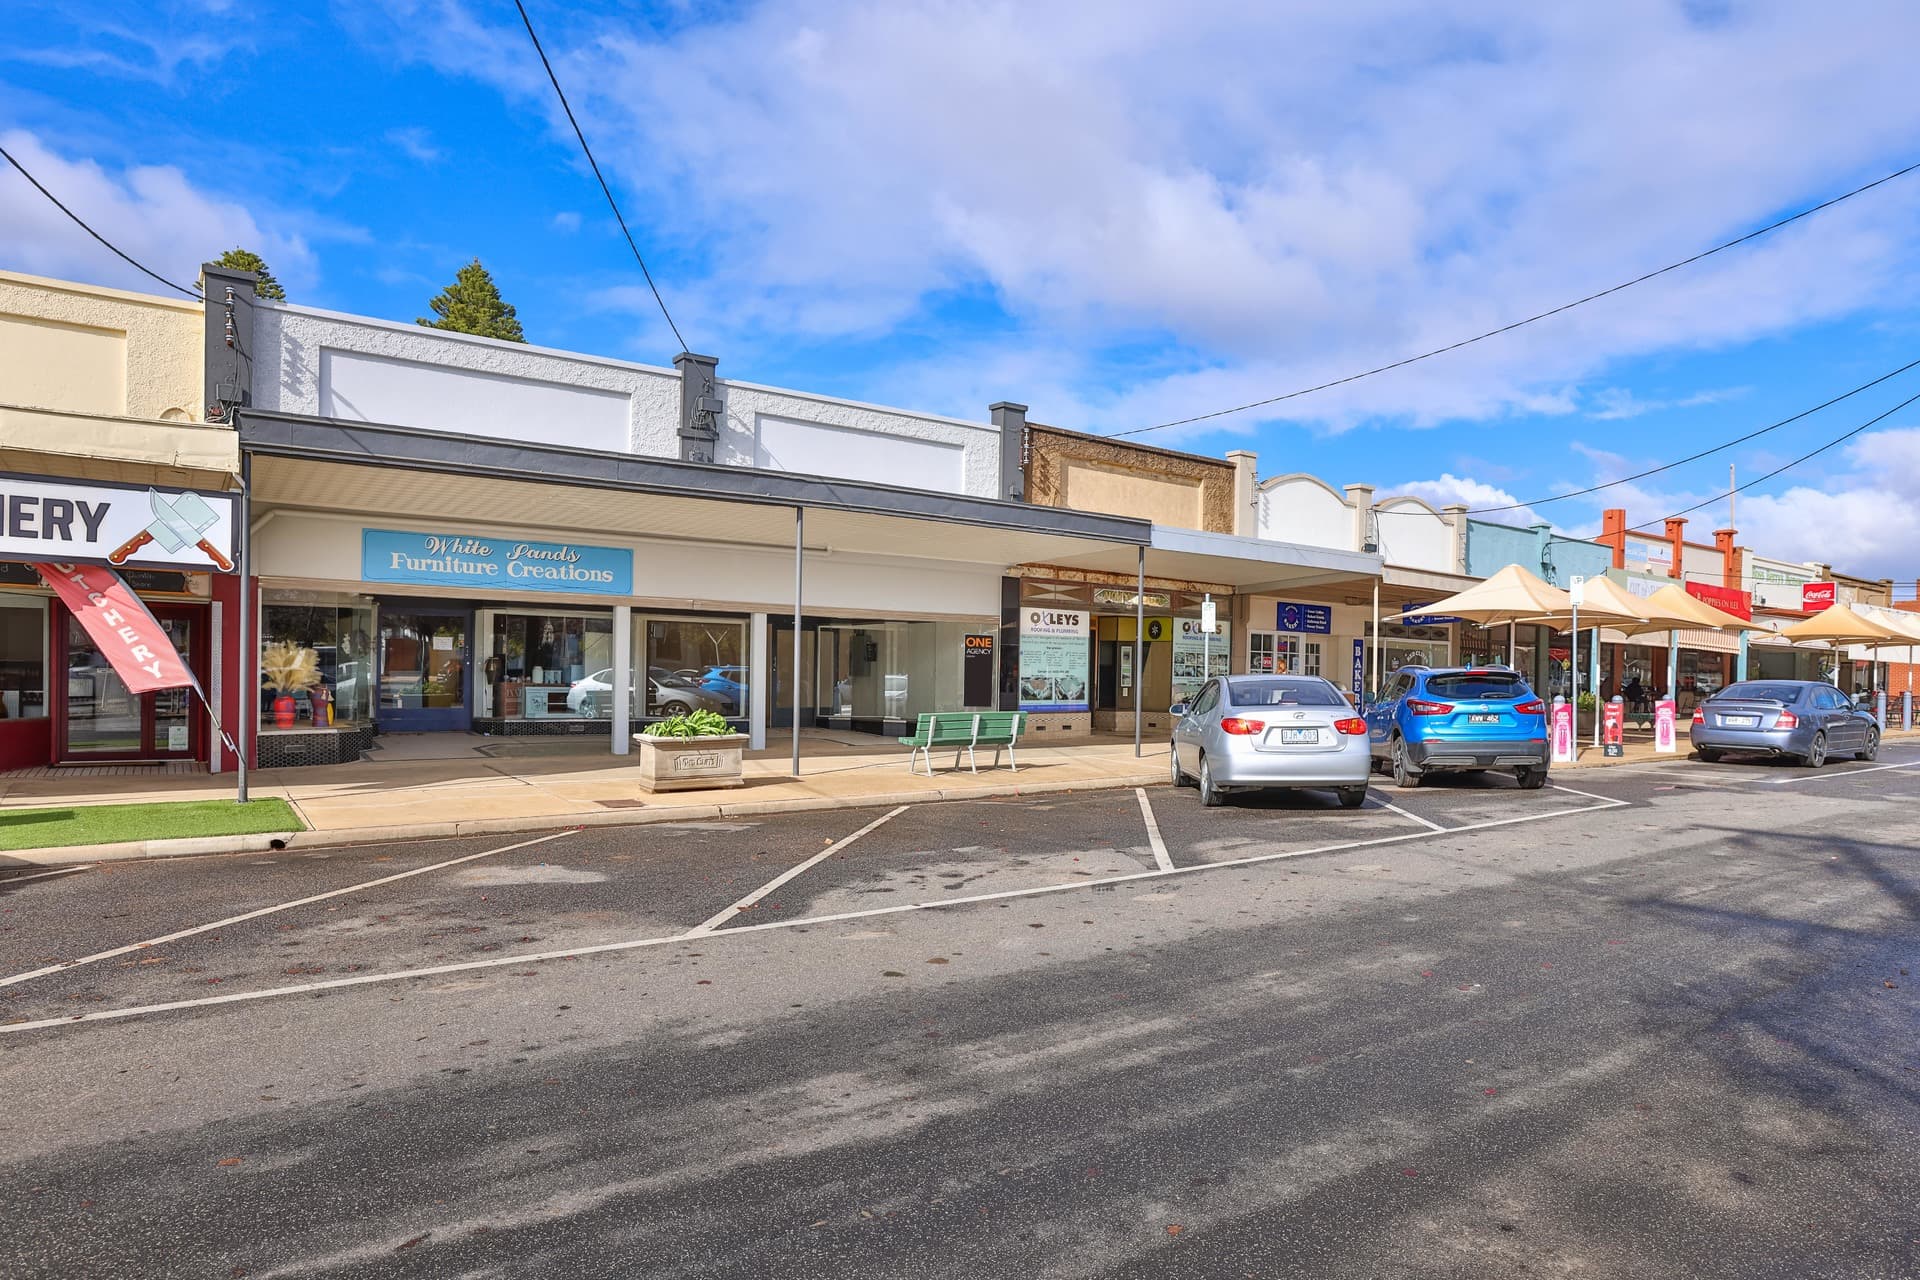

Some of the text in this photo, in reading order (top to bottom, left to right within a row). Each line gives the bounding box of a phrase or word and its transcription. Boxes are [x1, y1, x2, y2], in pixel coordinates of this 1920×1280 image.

[0, 494, 111, 543] ERY
[424, 536, 581, 562] White Sands
[389, 552, 614, 583] Furniture Creations
[1804, 589, 1833, 599] Coca-Cola
[966, 637, 992, 648] ONE
[1354, 646, 1362, 712] BAKERY
